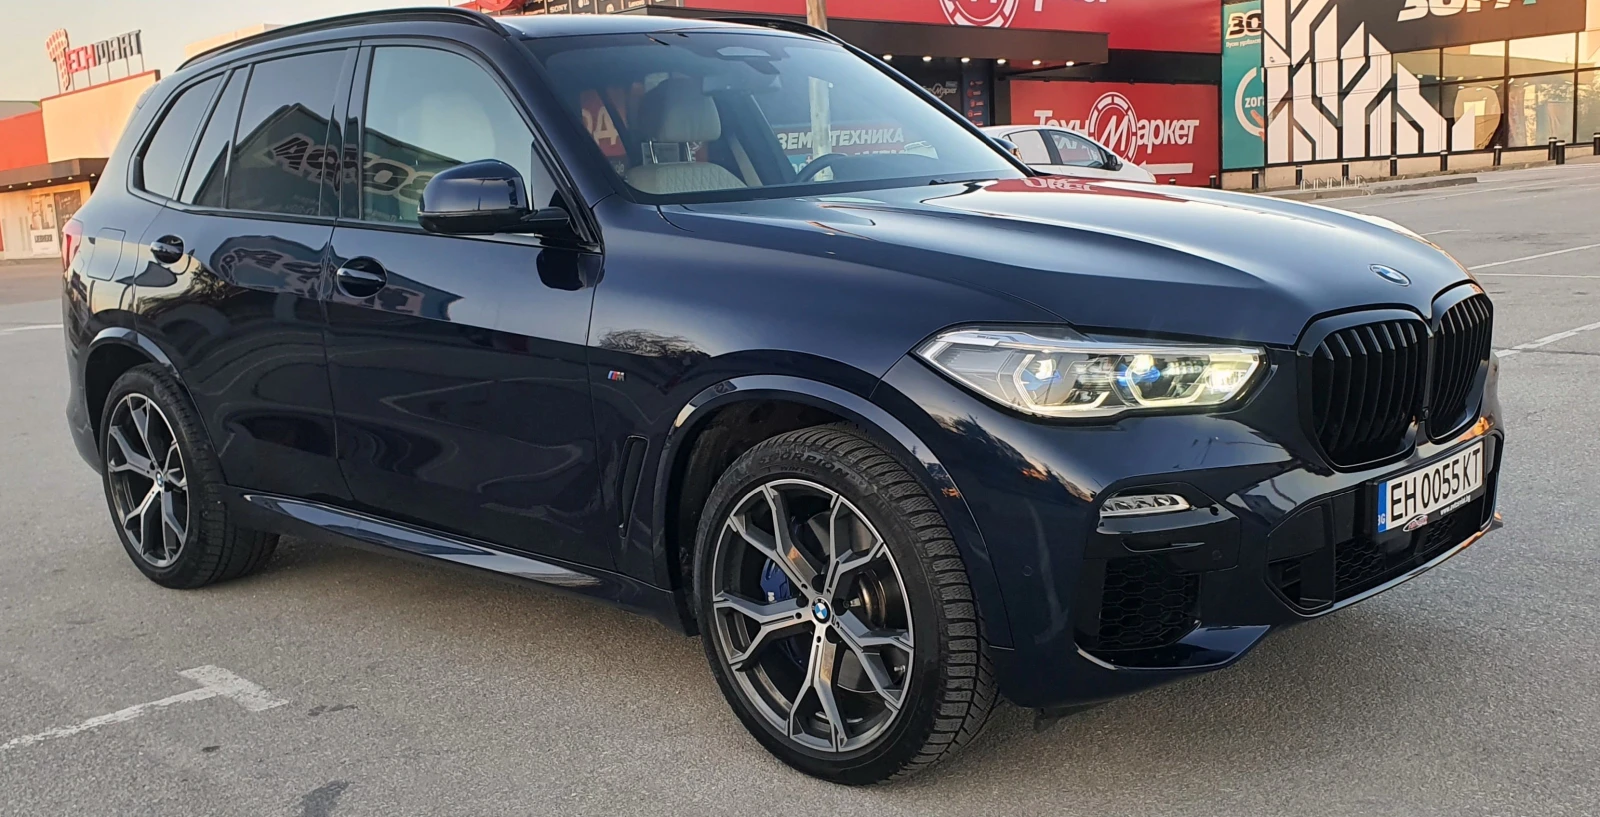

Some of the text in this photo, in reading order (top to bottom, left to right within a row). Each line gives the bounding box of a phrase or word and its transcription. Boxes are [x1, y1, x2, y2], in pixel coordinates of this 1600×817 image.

[549, 4, 568, 14] SONY
[45, 27, 142, 91] TECHMART
[1244, 95, 1264, 109] zor
